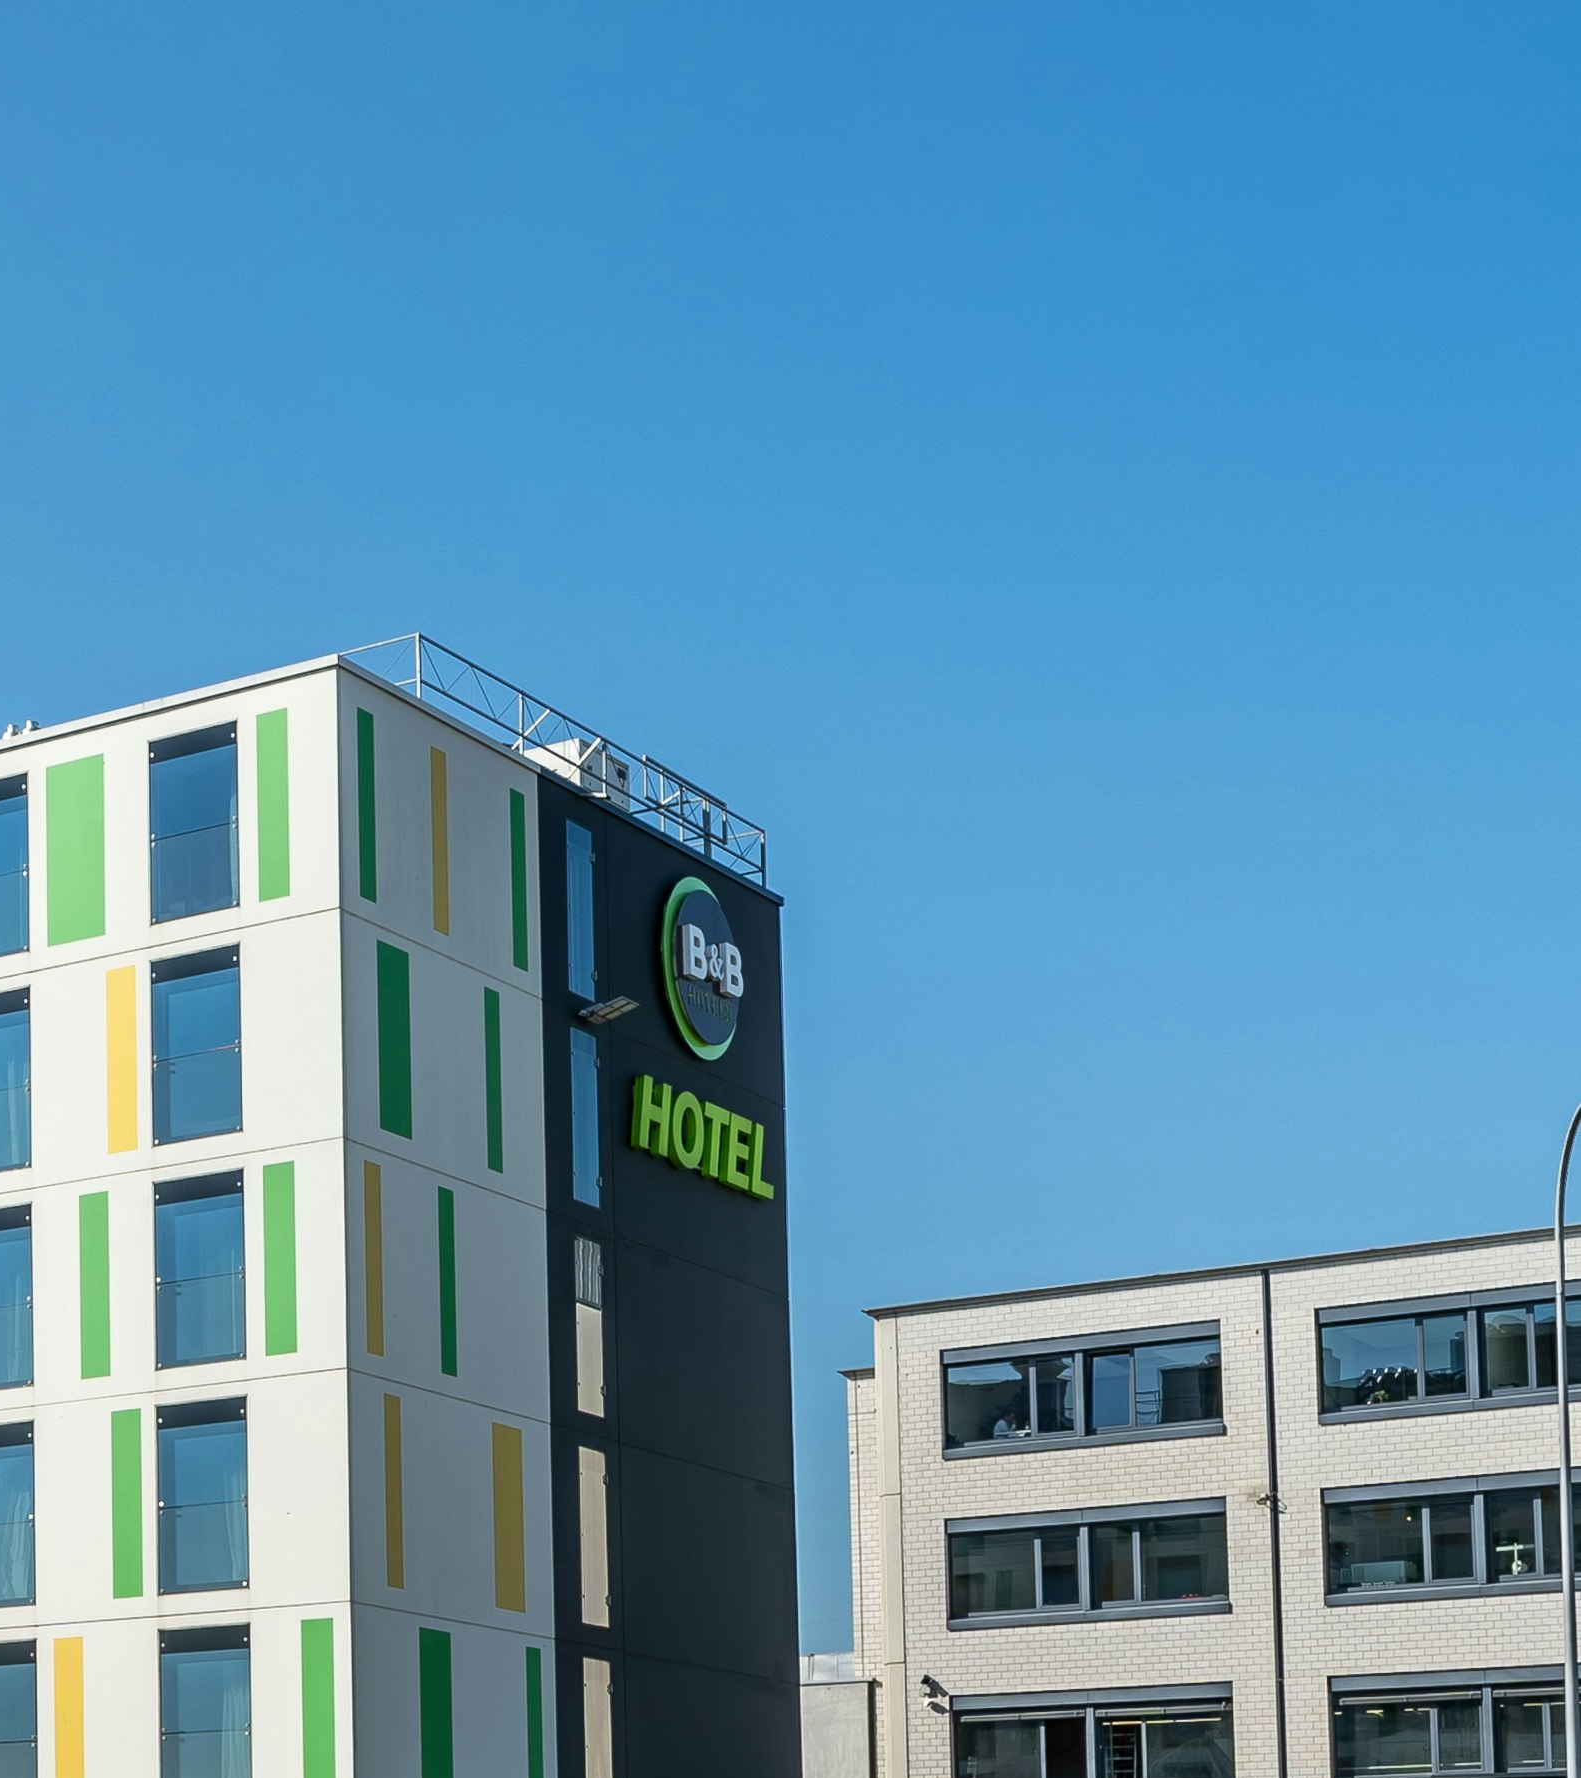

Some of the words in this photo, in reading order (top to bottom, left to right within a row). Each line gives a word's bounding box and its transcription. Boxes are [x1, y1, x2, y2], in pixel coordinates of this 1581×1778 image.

[682, 923, 744, 997] B&B
[687, 983, 732, 1024] HOTELS
[630, 1074, 775, 1200] HOTEL
